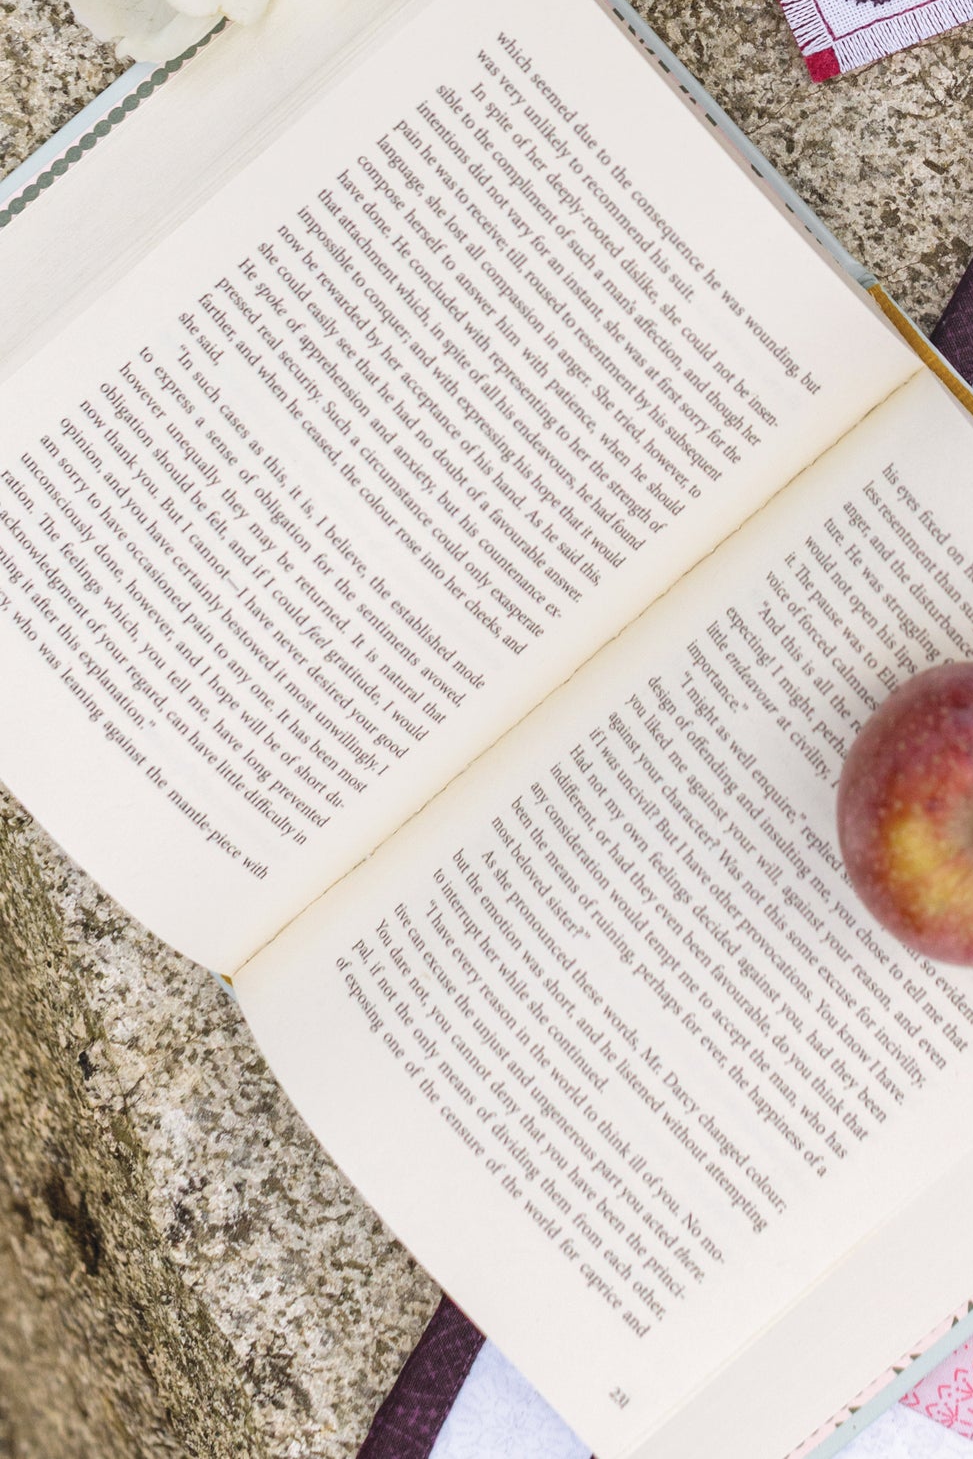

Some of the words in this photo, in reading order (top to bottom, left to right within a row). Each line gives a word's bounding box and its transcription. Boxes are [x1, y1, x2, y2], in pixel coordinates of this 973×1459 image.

[476, 48, 500, 77] was
[498, 74, 526, 107] very
[522, 104, 571, 159] unlikely
[567, 156, 584, 175] to
[580, 174, 655, 253] recommend
[648, 247, 671, 275] his
[667, 273, 694, 304] suit.
[496, 30, 532, 74] which
[529, 72, 578, 124] seemed
[572, 122, 598, 150] due
[595, 147, 611, 166] to
[609, 164, 632, 190] the
[630, 190, 705, 272] consequence
[702, 268, 721, 291] he
[720, 289, 745, 317] was
[744, 314, 800, 379] wounding,
[799, 370, 821, 395] but
[177, 311, 200, 336] she
[195, 334, 225, 367] said,
[356, 155, 405, 211] compose
[402, 207, 448, 255] herself
[440, 253, 456, 271] to
[454, 271, 497, 317] answer
[493, 314, 521, 347] him
[521, 346, 549, 379] with
[543, 377, 596, 435] patience,
[599, 432, 631, 467] when
[629, 462, 648, 483] he
[645, 481, 686, 517] should
[296, 204, 354, 274] impossible
[350, 270, 366, 288] to
[362, 287, 412, 344] conquer;
[408, 340, 437, 368] and
[431, 365, 459, 398] with
[455, 395, 516, 464] expressing
[511, 454, 533, 480] his
[529, 473, 561, 509] hope
[557, 504, 584, 531] that
[579, 524, 593, 540] it
[589, 535, 627, 569] would
[236, 256, 258, 282] He
[253, 281, 287, 317] spoke
[284, 317, 306, 334] of
[297, 333, 370, 418] apprehension
[368, 417, 398, 445] and
[392, 444, 437, 495] anxiety,
[435, 489, 460, 518] but
[457, 513, 479, 538] his
[477, 538, 546, 604] countenance
[543, 602, 562, 618] ex-
[138, 345, 154, 364] to
[153, 365, 196, 415] express
[193, 416, 205, 428] a
[204, 429, 238, 466] sense
[237, 468, 260, 485] of
[253, 487, 312, 554] obligation
[311, 552, 335, 576] for
[333, 576, 356, 601] the
[355, 603, 421, 667] sentiments
[419, 666, 467, 708] avowed,
[861, 479, 882, 507] less
[877, 503, 937, 573] resentment
[932, 569, 962, 603] than
[881, 461, 899, 486] his
[895, 484, 921, 512] eyes
[917, 509, 951, 546] fixed
[945, 545, 964, 566] on
[59, 417, 103, 474] opinion,
[102, 471, 131, 500] and
[119, 496, 149, 525] you
[144, 519, 174, 556] have
[171, 555, 224, 613] certainly
[219, 607, 280, 672] bestowed
[272, 667, 288, 683] it
[283, 680, 318, 714] most
[313, 710, 379, 772] unwillingly.
[376, 763, 390, 777] I
[0, 468, 35, 515] ration.
[37, 511, 60, 542] The
[58, 541, 103, 595] feelings
[102, 595, 139, 643] which,
[137, 641, 166, 671] you
[165, 669, 192, 695] tell
[186, 694, 210, 722] me,
[211, 717, 243, 752] have
[241, 748, 272, 784] long
[266, 779, 331, 828] prevented
[490, 815, 515, 849] most
[509, 842, 553, 898] beloved
[623, 692, 647, 719] you
[642, 713, 674, 751] liked
[667, 749, 688, 773] me
[685, 773, 728, 823] against
[722, 821, 757, 854] your
[755, 854, 783, 887] will,
[780, 885, 825, 932] against
[818, 930, 853, 963] your
[851, 963, 891, 1012] reason,
[892, 1010, 922, 1038] and
[917, 1038, 947, 1070] even
[350, 937, 375, 965] pal,
[368, 960, 386, 977] if
[431, 867, 446, 885] to
[440, 879, 483, 941] interrupt
[477, 934, 500, 963] her
[497, 961, 529, 1001] while
[526, 1000, 549, 1025] she
[546, 1024, 609, 1094] continued.
[568, 743, 594, 775] Had
[586, 772, 608, 798] not
[603, 797, 625, 822] my
[622, 822, 649, 853] own
[647, 851, 693, 905] feelings
[691, 904, 742, 957] decided
[736, 956, 781, 1003] against
[774, 1001, 803, 1034] you,
[804, 1028, 834, 1060] had
[829, 1058, 859, 1090] they
[856, 1085, 887, 1124] been
[376, 976, 398, 1003] not
[393, 1001, 414, 1026] the
[480, 849, 497, 870] As
[492, 867, 512, 892] she
[504, 890, 577, 971] pronounced
[570, 968, 603, 1006] these
[602, 1004, 639, 1051] words,
[639, 1046, 662, 1075] Mr.
[661, 1070, 700, 1114] Darcy
[697, 1113, 750, 1168] changed
[744, 1166, 787, 1214] colour;
[411, 1027, 439, 1060] only
[437, 1060, 474, 1106] means
[475, 1106, 497, 1123] of
[490, 1123, 540, 1181] dividing
[539, 1177, 572, 1215] them
[571, 1212, 603, 1249] from
[602, 1249, 632, 1281] each
[631, 1280, 666, 1321] other,
